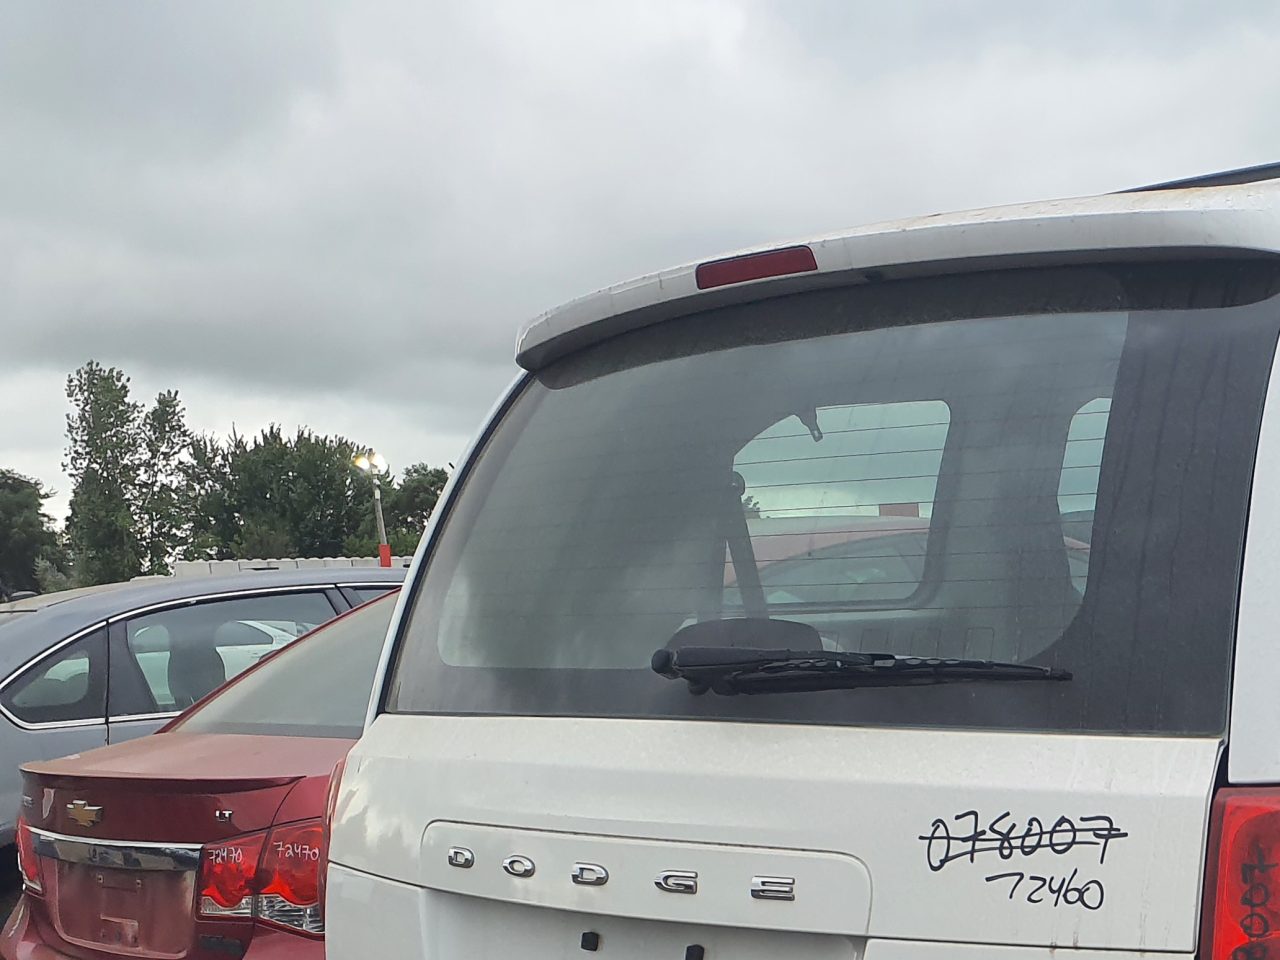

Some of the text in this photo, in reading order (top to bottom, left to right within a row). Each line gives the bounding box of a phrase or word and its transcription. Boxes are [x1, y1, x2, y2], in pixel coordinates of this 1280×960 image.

[215, 809, 233, 822] LT
[207, 845, 243, 865] 72470
[272, 840, 321, 862] 72470
[918, 810, 1129, 872] 078007
[447, 845, 796, 902] DODGE
[985, 867, 1105, 911] 72460
